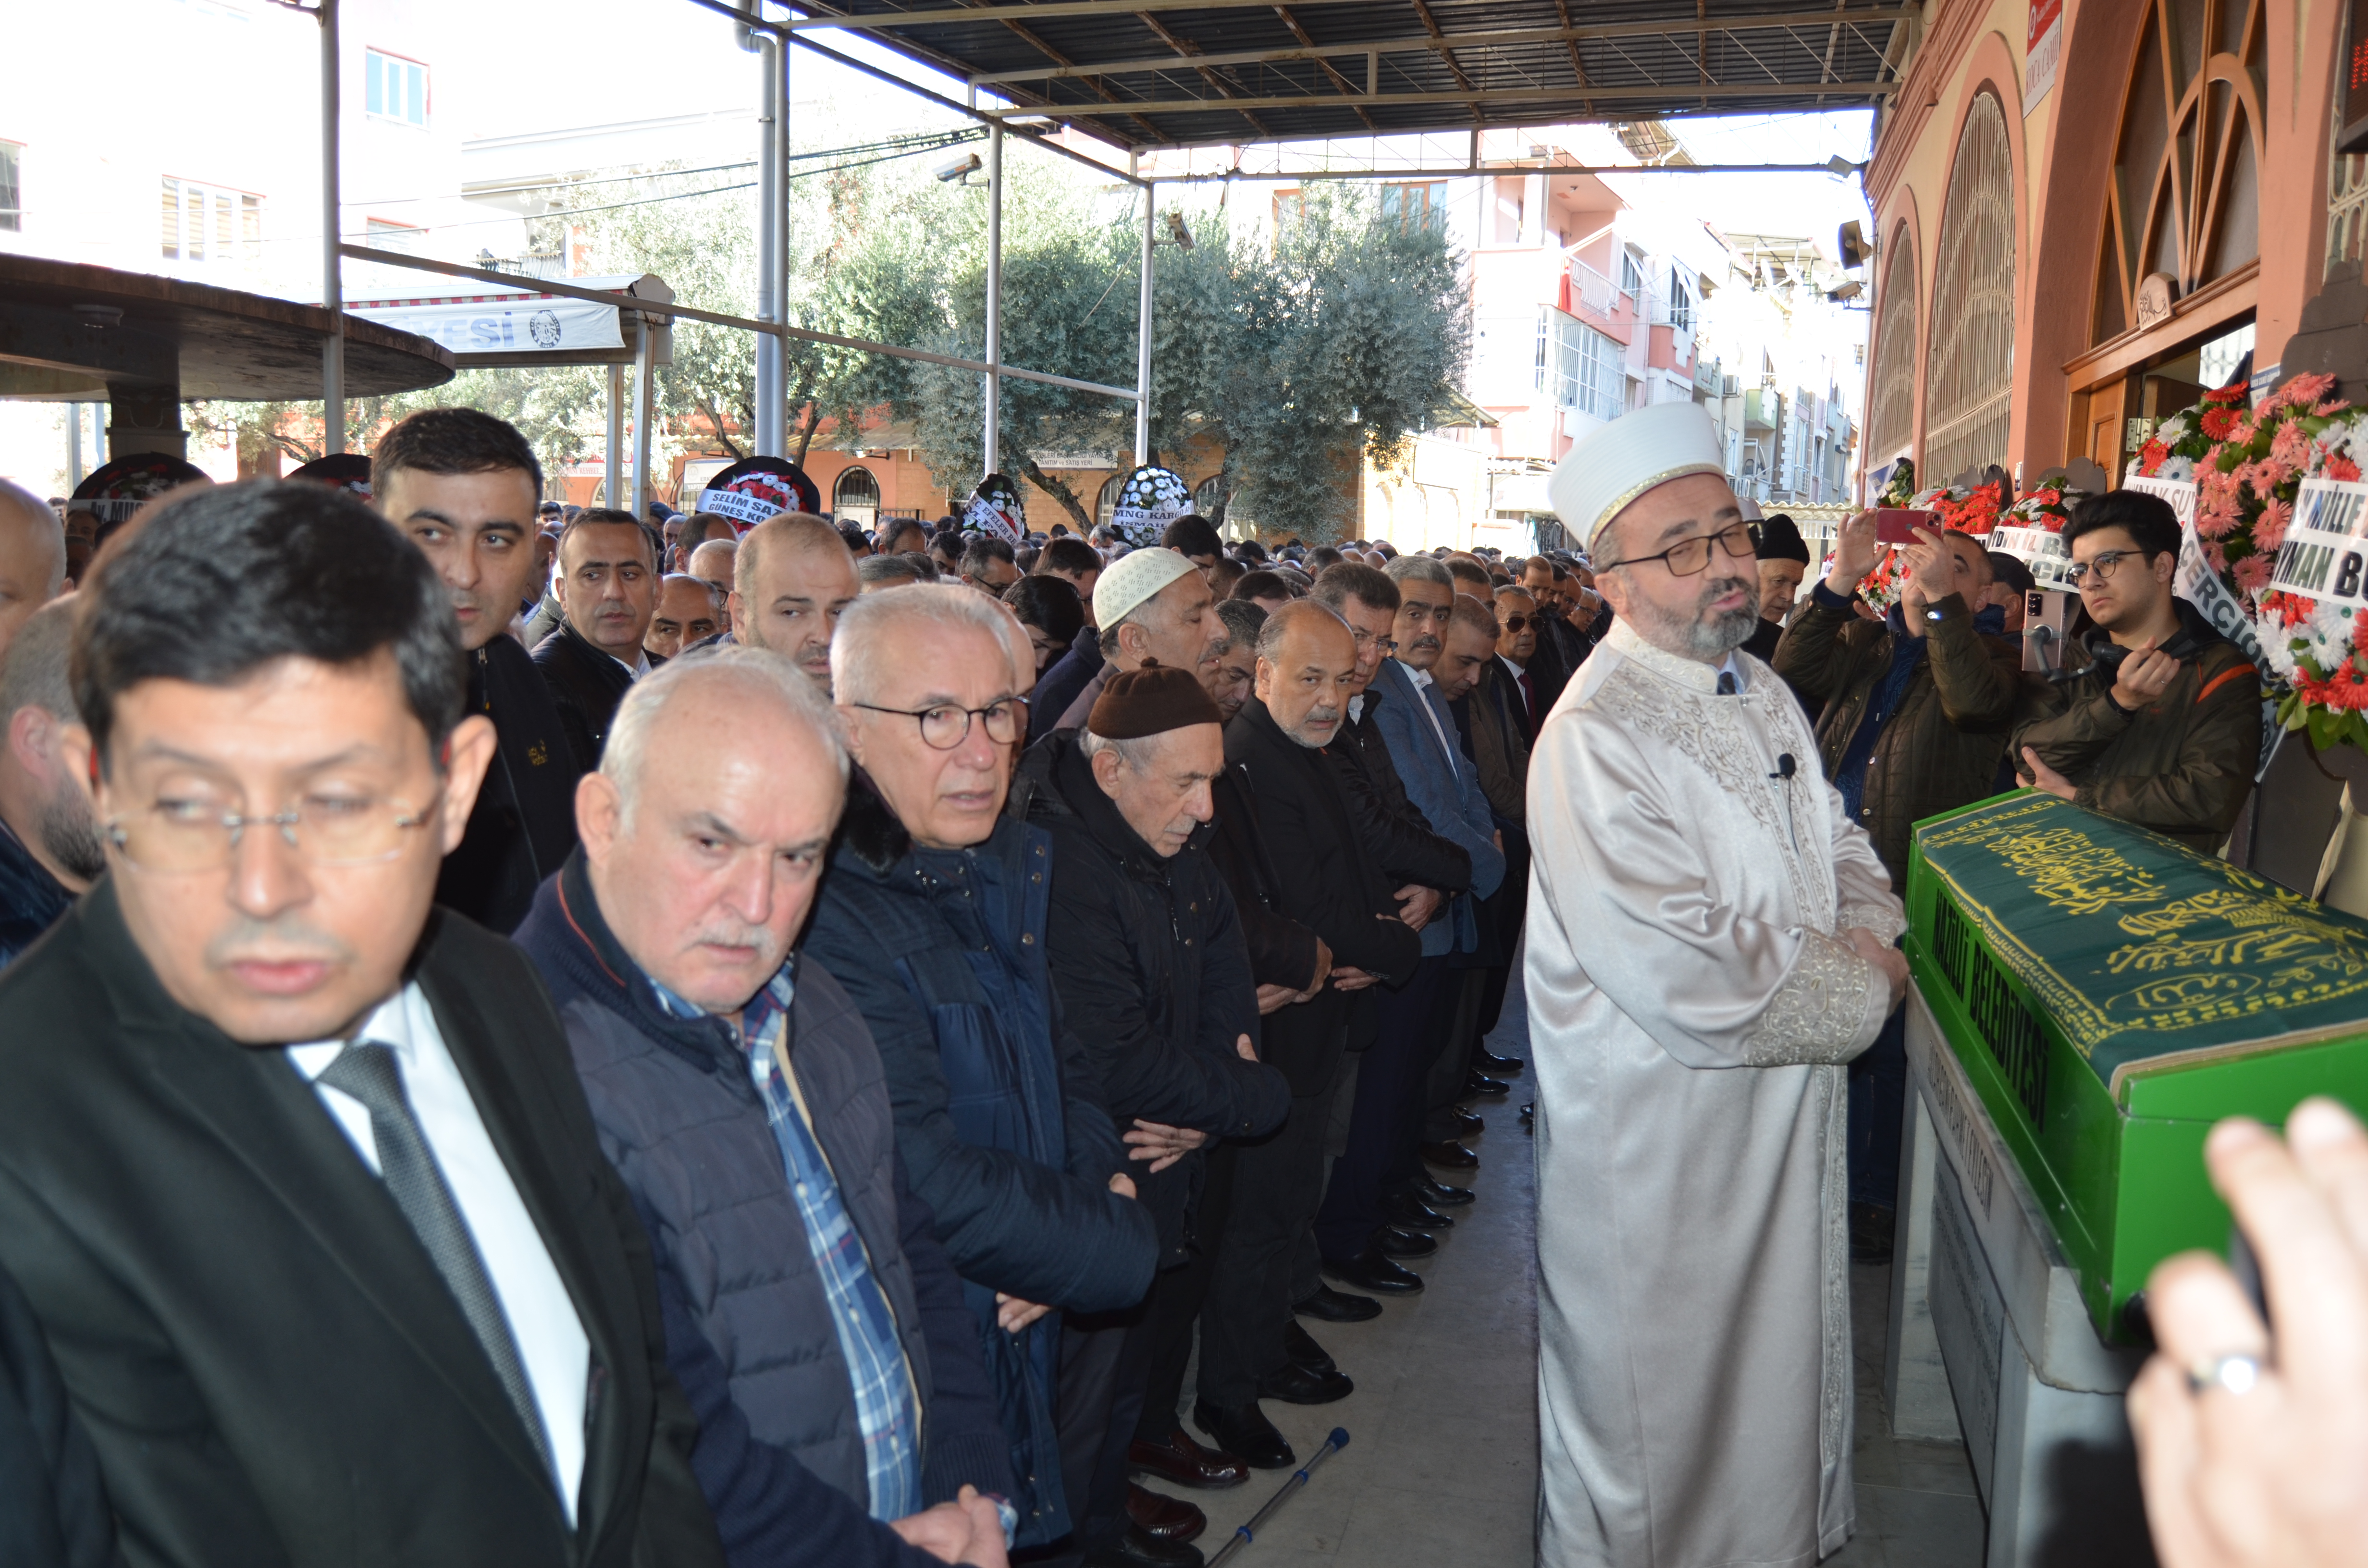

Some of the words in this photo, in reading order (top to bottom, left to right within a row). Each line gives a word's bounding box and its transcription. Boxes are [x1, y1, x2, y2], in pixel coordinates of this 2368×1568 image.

[2025, 57, 2040, 98] KOCA
[713, 493, 749, 507] SELİM
[709, 503, 744, 517] GÜNEŞ
[1113, 509, 1145, 519] MNG
[1148, 509, 1184, 519] KARGO
[982, 506, 1009, 535] EFELER
